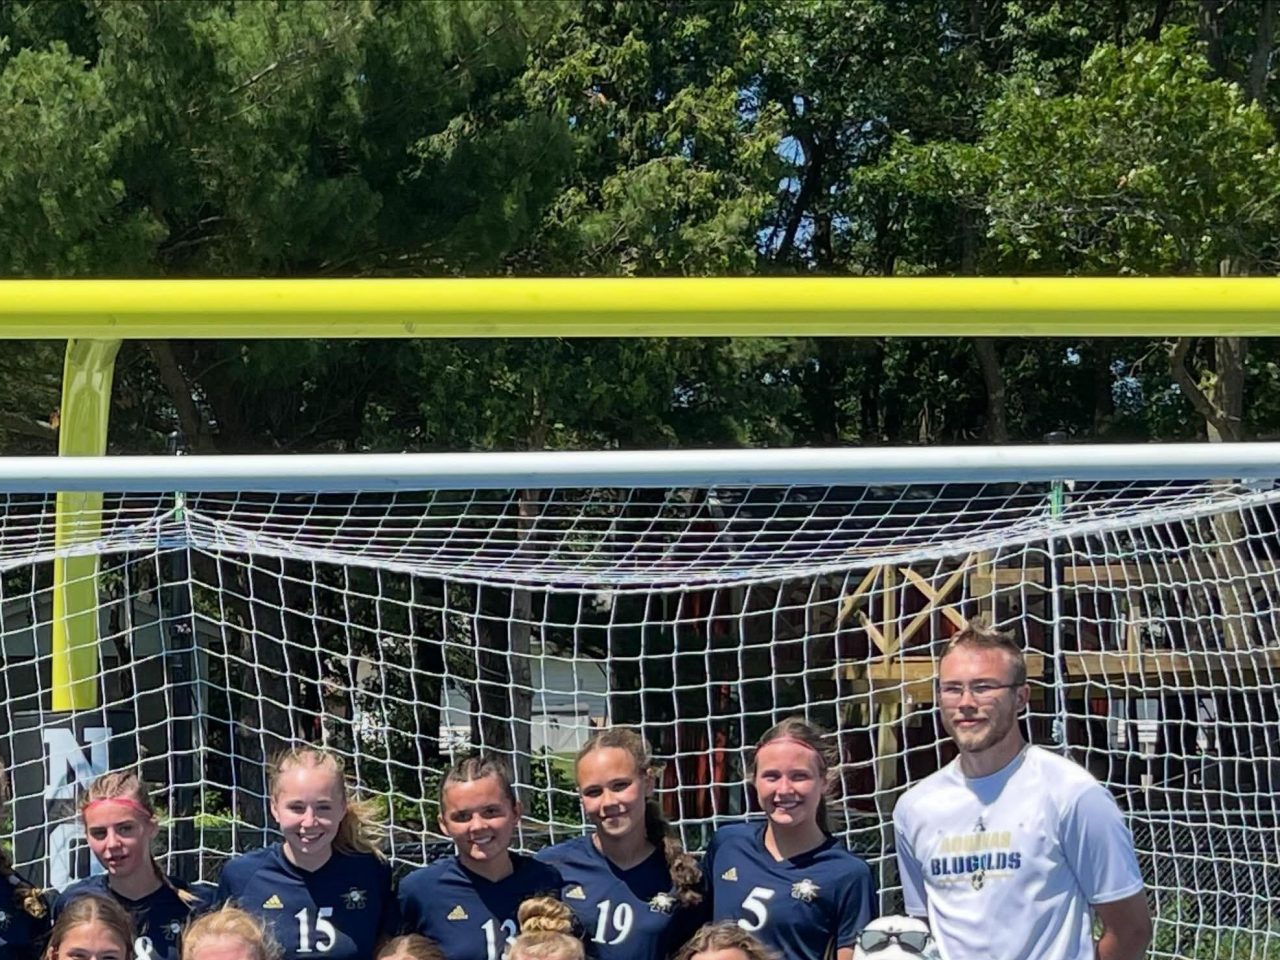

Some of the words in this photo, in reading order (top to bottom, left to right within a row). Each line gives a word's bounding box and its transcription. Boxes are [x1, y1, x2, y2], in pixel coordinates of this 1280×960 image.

[43, 727, 113, 799] N
[295, 908, 335, 952] 15
[591, 900, 634, 945] 19
[738, 887, 776, 931] 5
